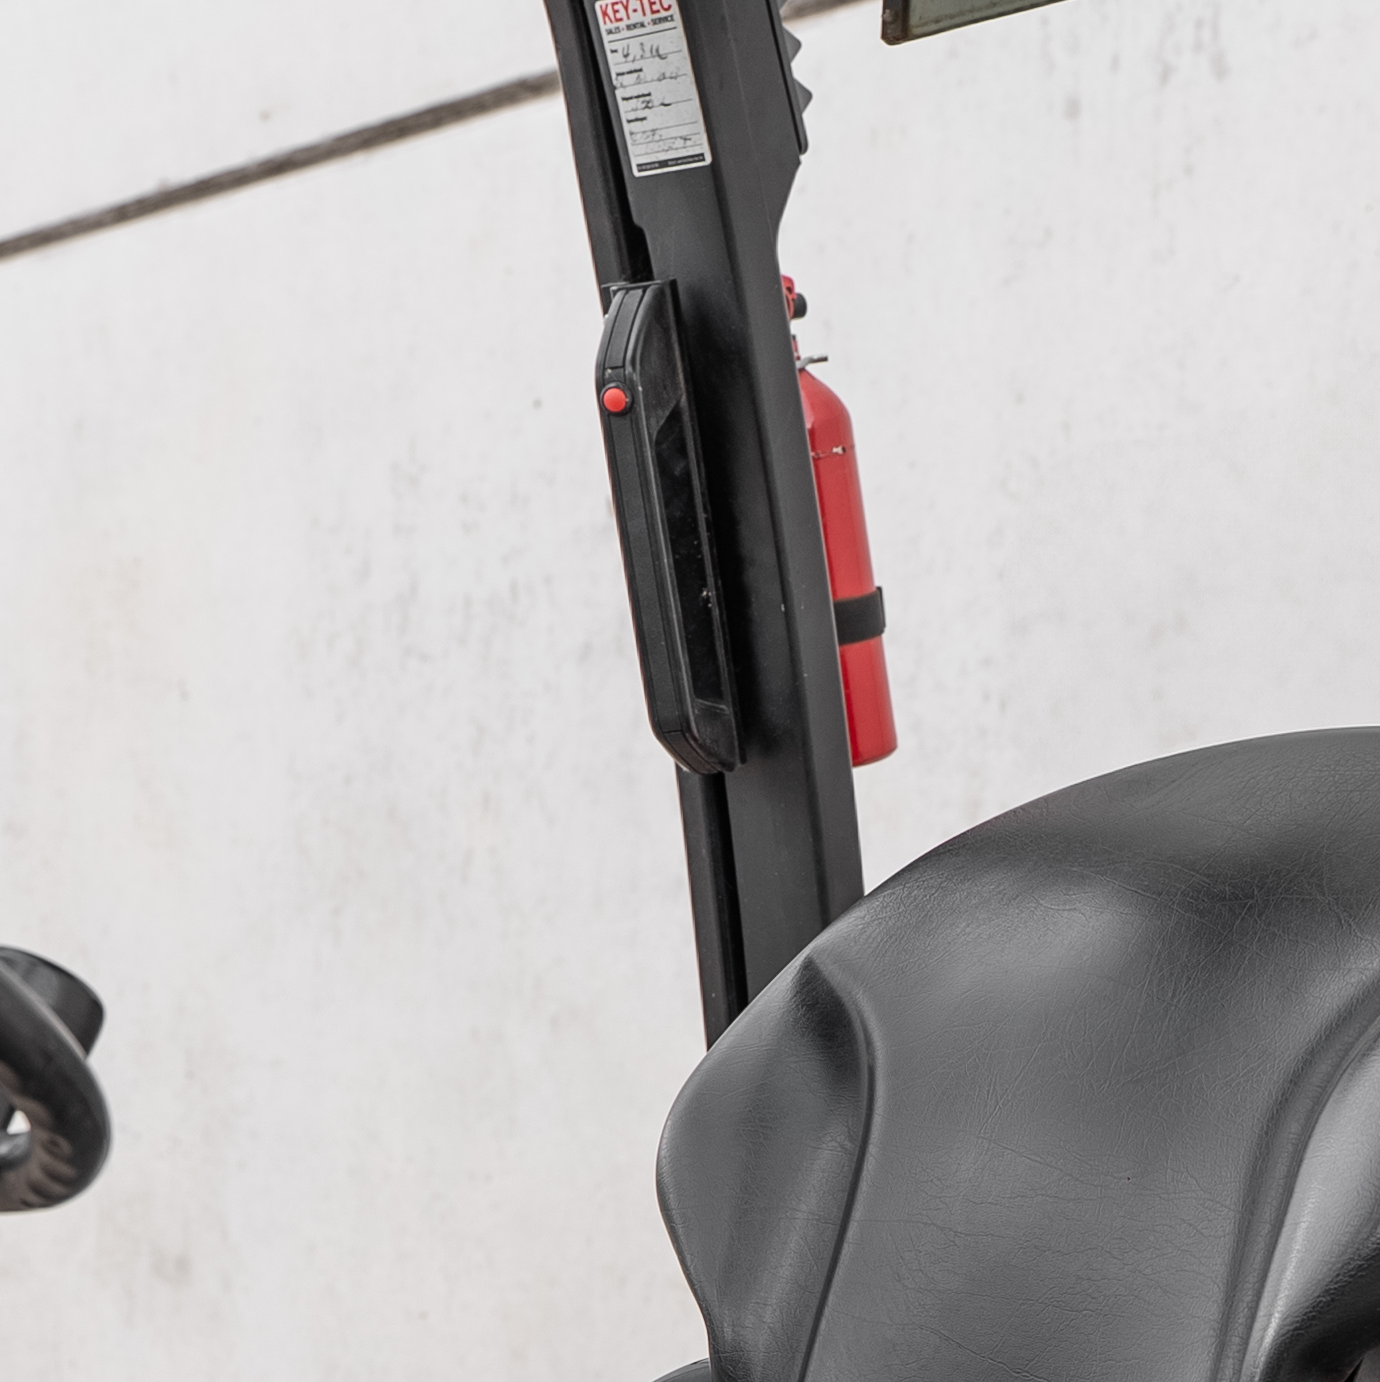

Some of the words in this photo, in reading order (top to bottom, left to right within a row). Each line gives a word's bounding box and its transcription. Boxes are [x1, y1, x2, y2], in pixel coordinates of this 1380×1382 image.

[600, 0, 672, 25] KEY-TEC
[626, 21, 646, 32] RENTAL
[651, 14, 675, 26] SERVICE
